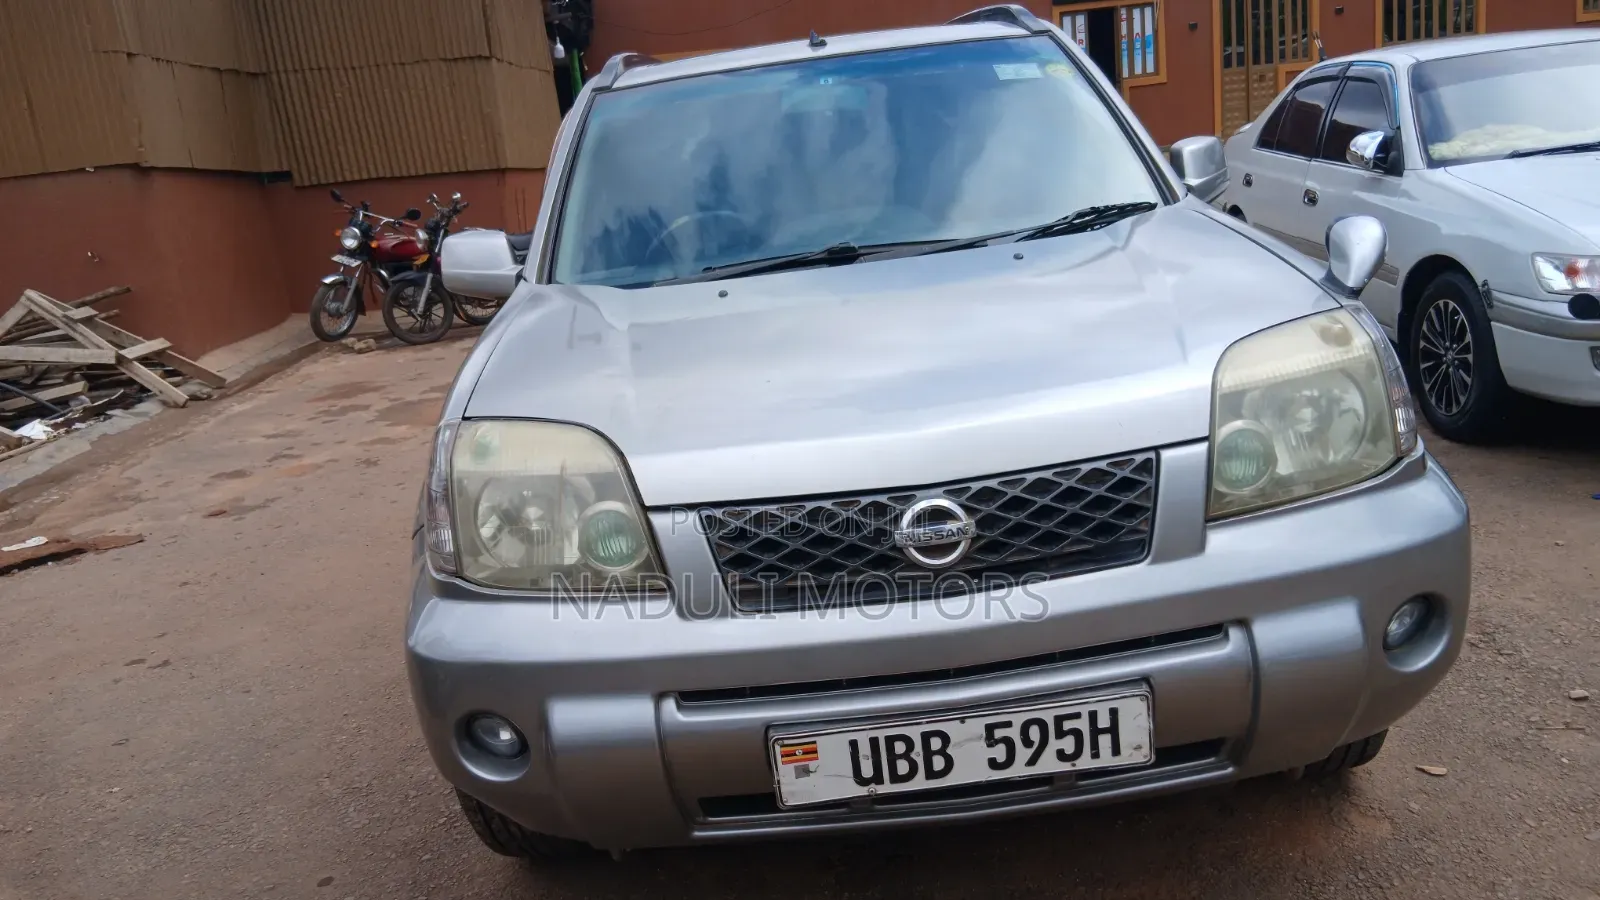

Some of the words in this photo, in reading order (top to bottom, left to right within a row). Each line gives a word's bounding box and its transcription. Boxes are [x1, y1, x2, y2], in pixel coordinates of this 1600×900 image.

[901, 526, 969, 544] NISSAN
[849, 730, 955, 787] UBB
[985, 707, 1122, 771] 595H
